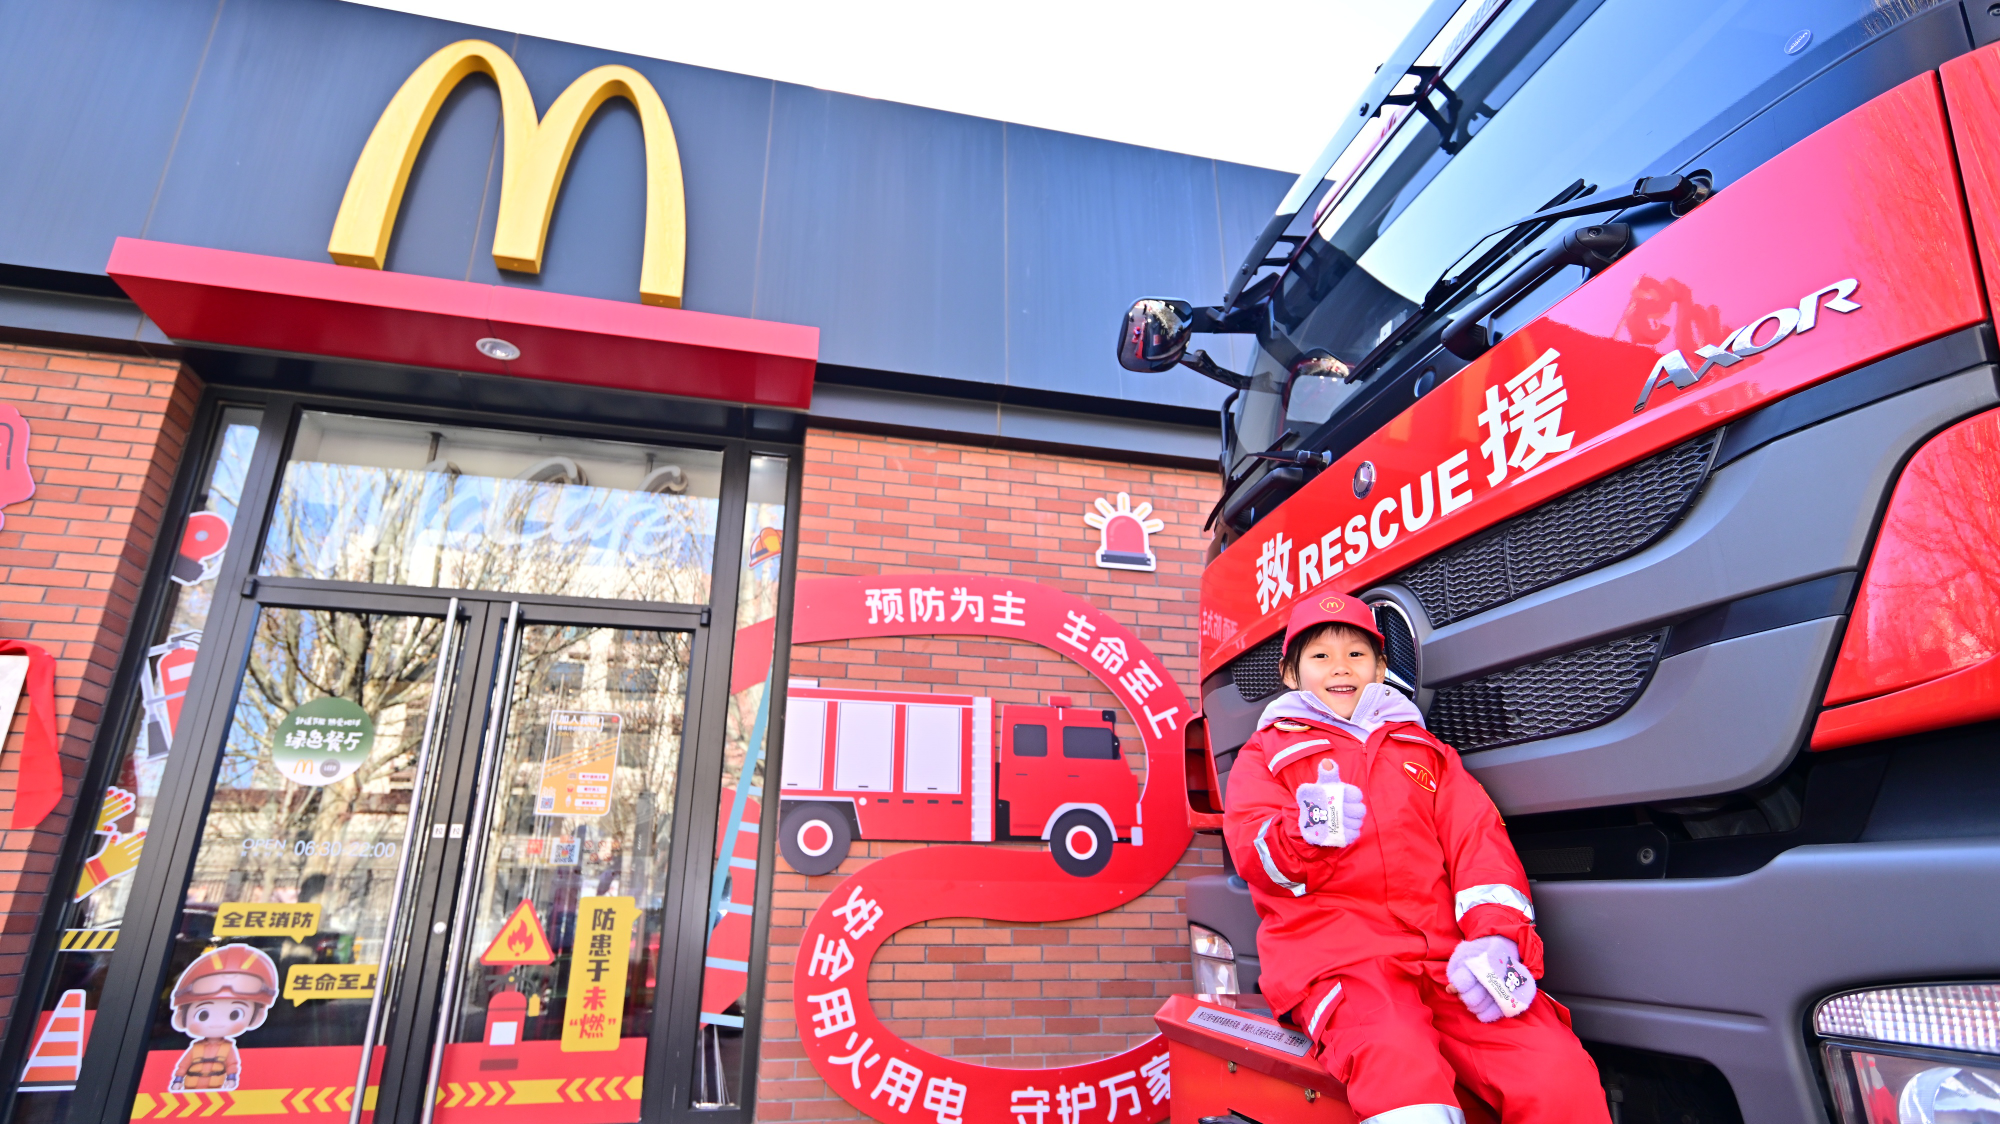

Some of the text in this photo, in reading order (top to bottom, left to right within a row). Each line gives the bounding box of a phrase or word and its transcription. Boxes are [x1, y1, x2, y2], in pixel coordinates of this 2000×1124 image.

[1633, 278, 1862, 414] AXOR
[1255, 347, 1576, 615] 救 RESCUE 援
[865, 587, 1178, 739] 预防为主 生命至上
[284, 729, 363, 753] 绿色餐厅
[242, 838, 397, 858] OPEN 06:30-22:00
[222, 911, 314, 928] 全民消防
[292, 973, 377, 991] 生命至上
[807, 885, 967, 1124] 安全用火用电
